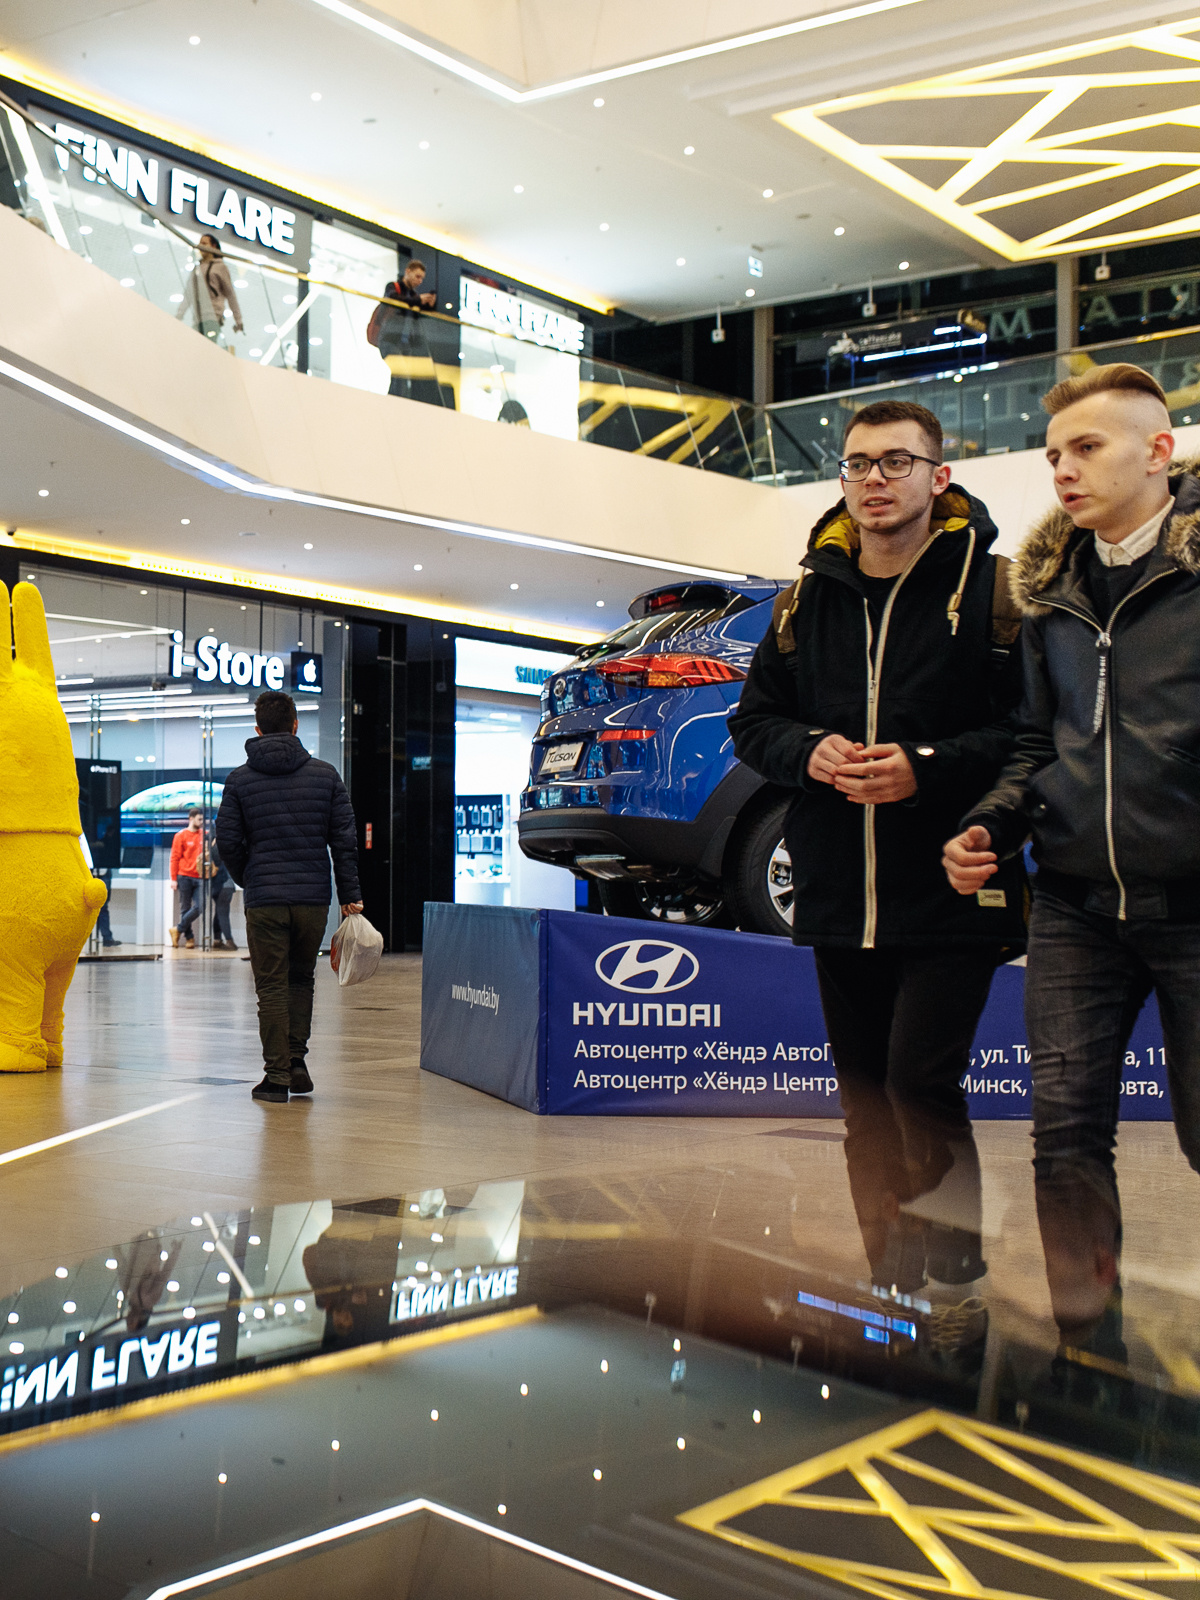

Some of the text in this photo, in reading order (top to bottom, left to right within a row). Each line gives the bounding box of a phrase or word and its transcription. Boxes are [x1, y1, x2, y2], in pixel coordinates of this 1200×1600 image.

[170, 168, 296, 255] FLARE
[172, 630, 285, 690] i-Store
[451, 981, 500, 1016] www.hyundai.by
[573, 1002, 721, 1027] HYUNDAI
[574, 1040, 687, 1064] Автоцентр
[573, 1070, 687, 1094] Автоцентр
[773, 1072, 839, 1096] Центр
